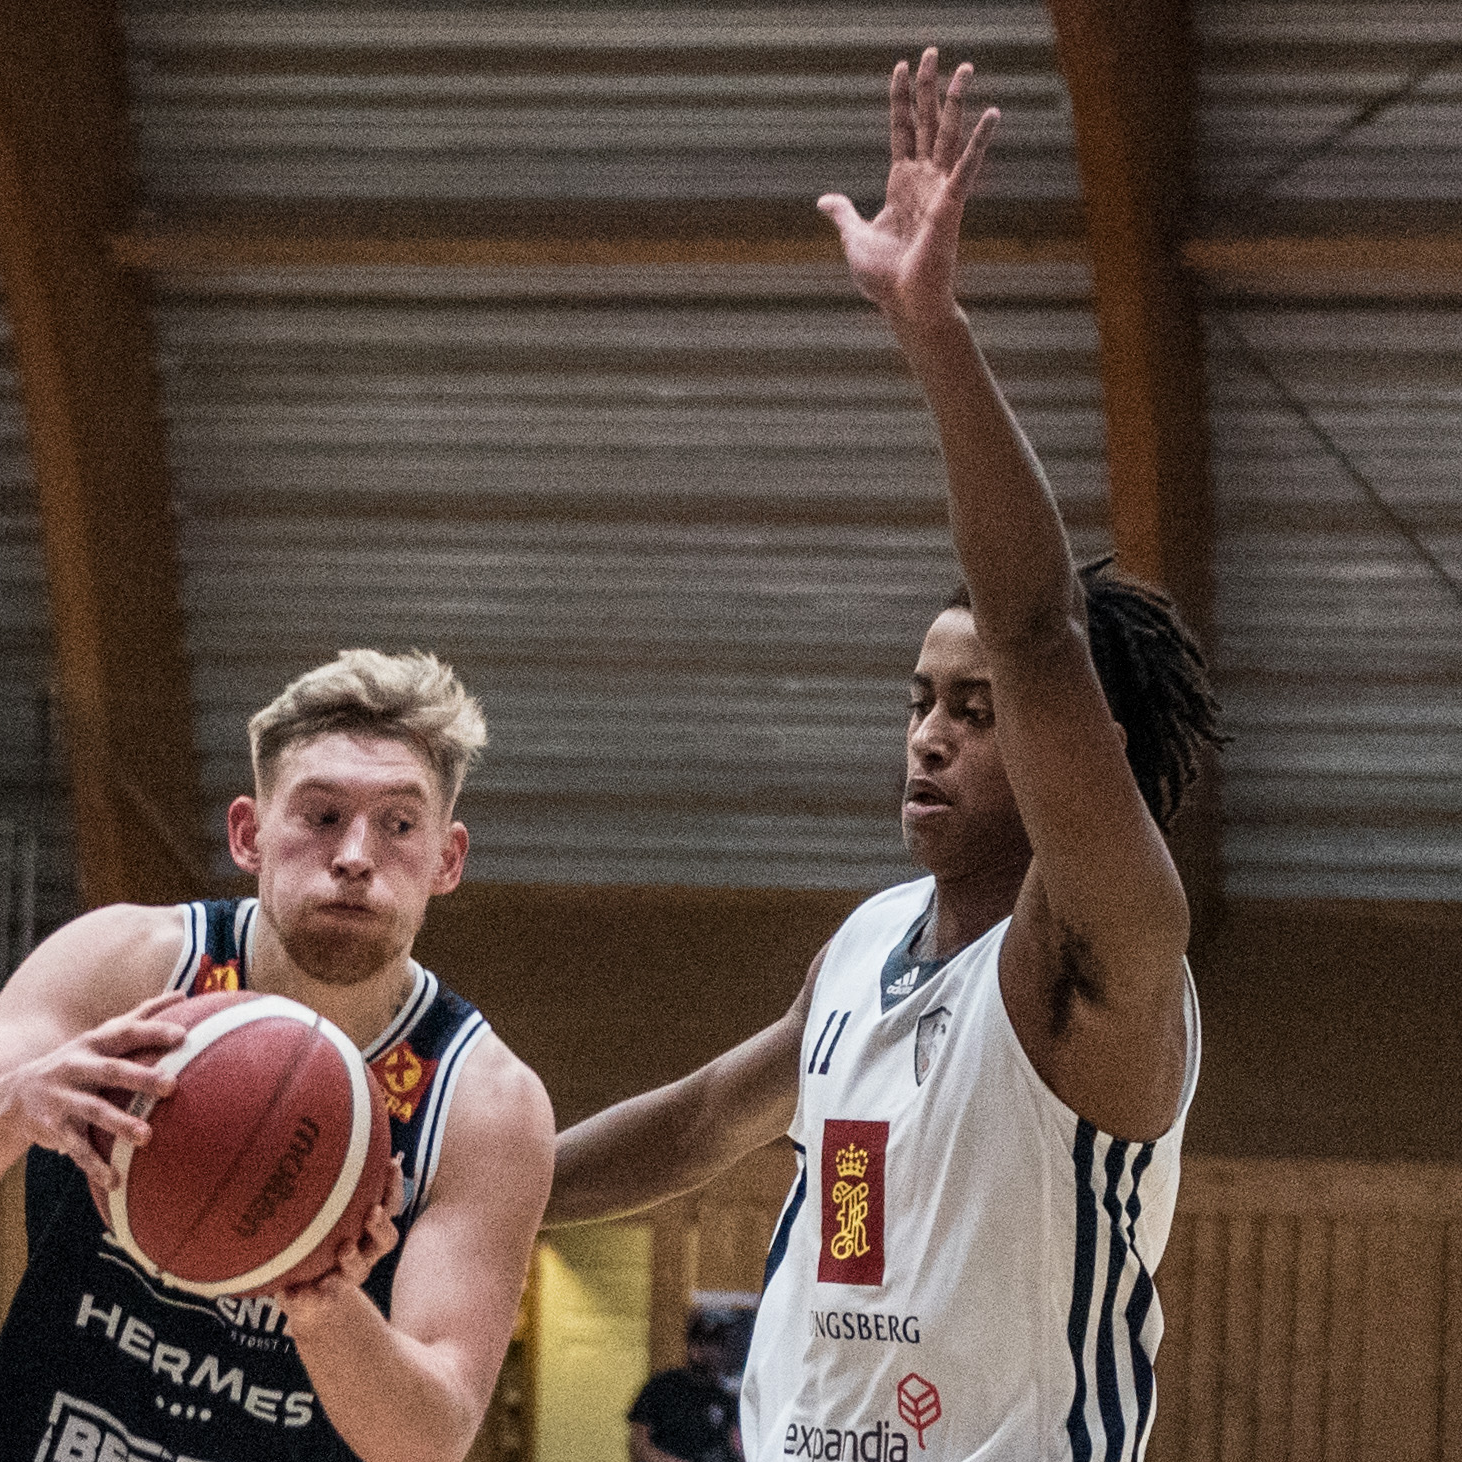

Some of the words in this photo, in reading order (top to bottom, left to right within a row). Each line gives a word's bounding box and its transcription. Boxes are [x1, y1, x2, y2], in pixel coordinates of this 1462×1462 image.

[807, 1009, 851, 1076] 11
[809, 1309, 921, 1345] NGSBERG
[76, 1294, 315, 1428] HERMES
